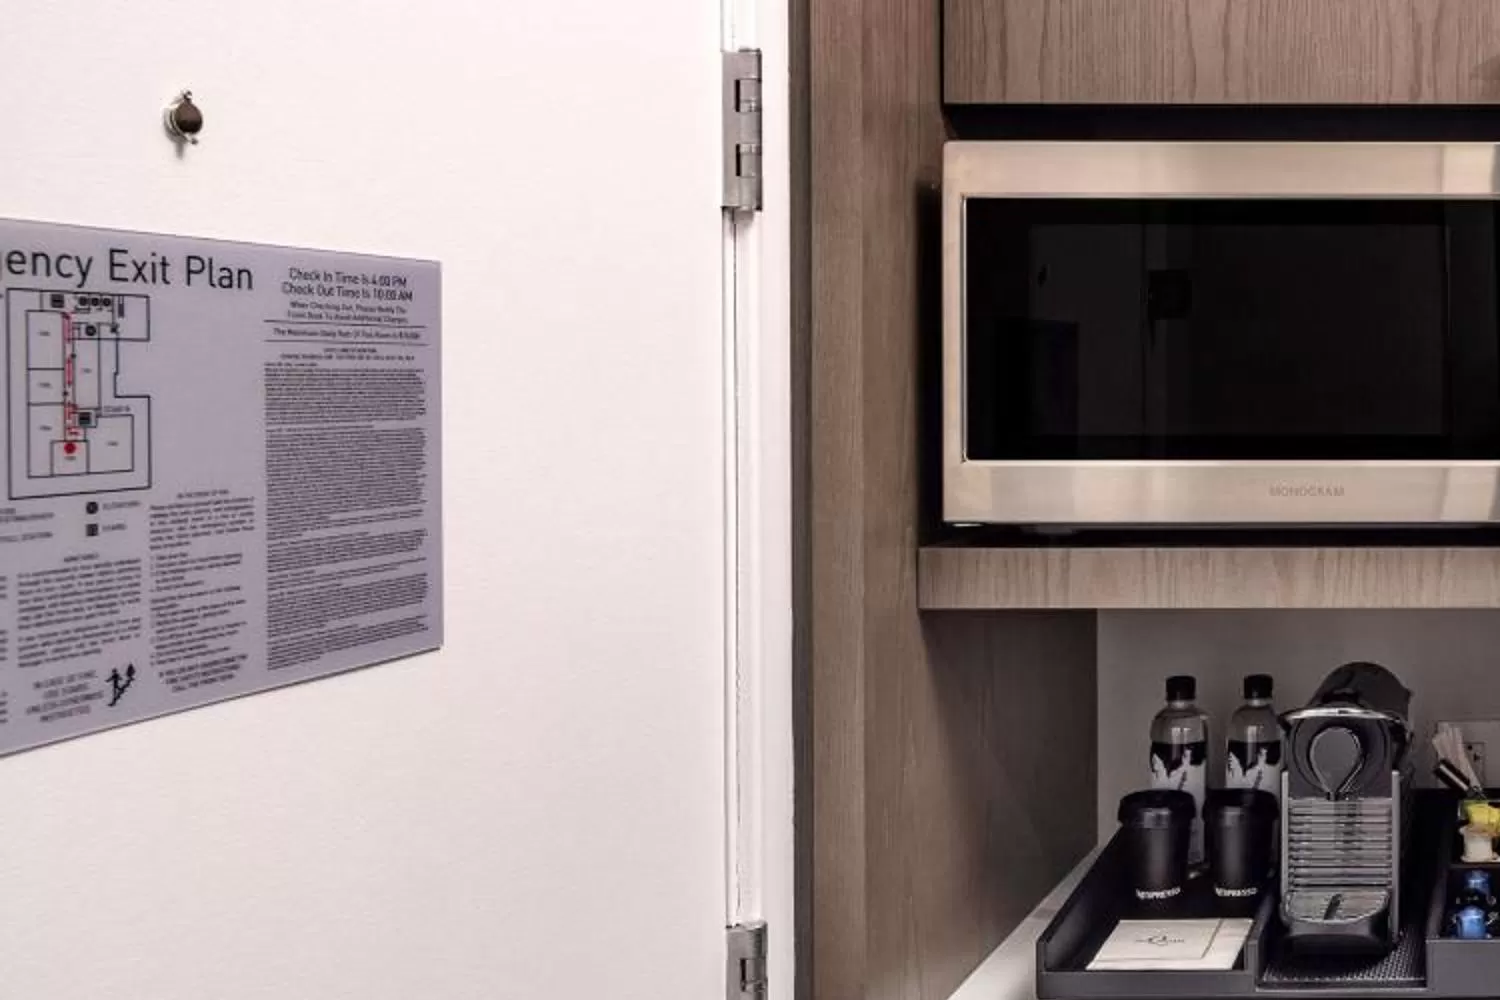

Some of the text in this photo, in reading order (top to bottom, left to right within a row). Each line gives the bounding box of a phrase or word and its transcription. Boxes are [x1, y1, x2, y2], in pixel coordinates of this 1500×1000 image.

[0, 248, 253, 290] ency Exit Plan
[289, 267, 321, 282] Check
[323, 272, 333, 282] In
[335, 271, 360, 284] Time
[392, 276, 407, 287] PM
[282, 281, 315, 295] Check
[316, 284, 335, 297] Out
[337, 286, 360, 299] Time
[398, 290, 413, 301] AM
